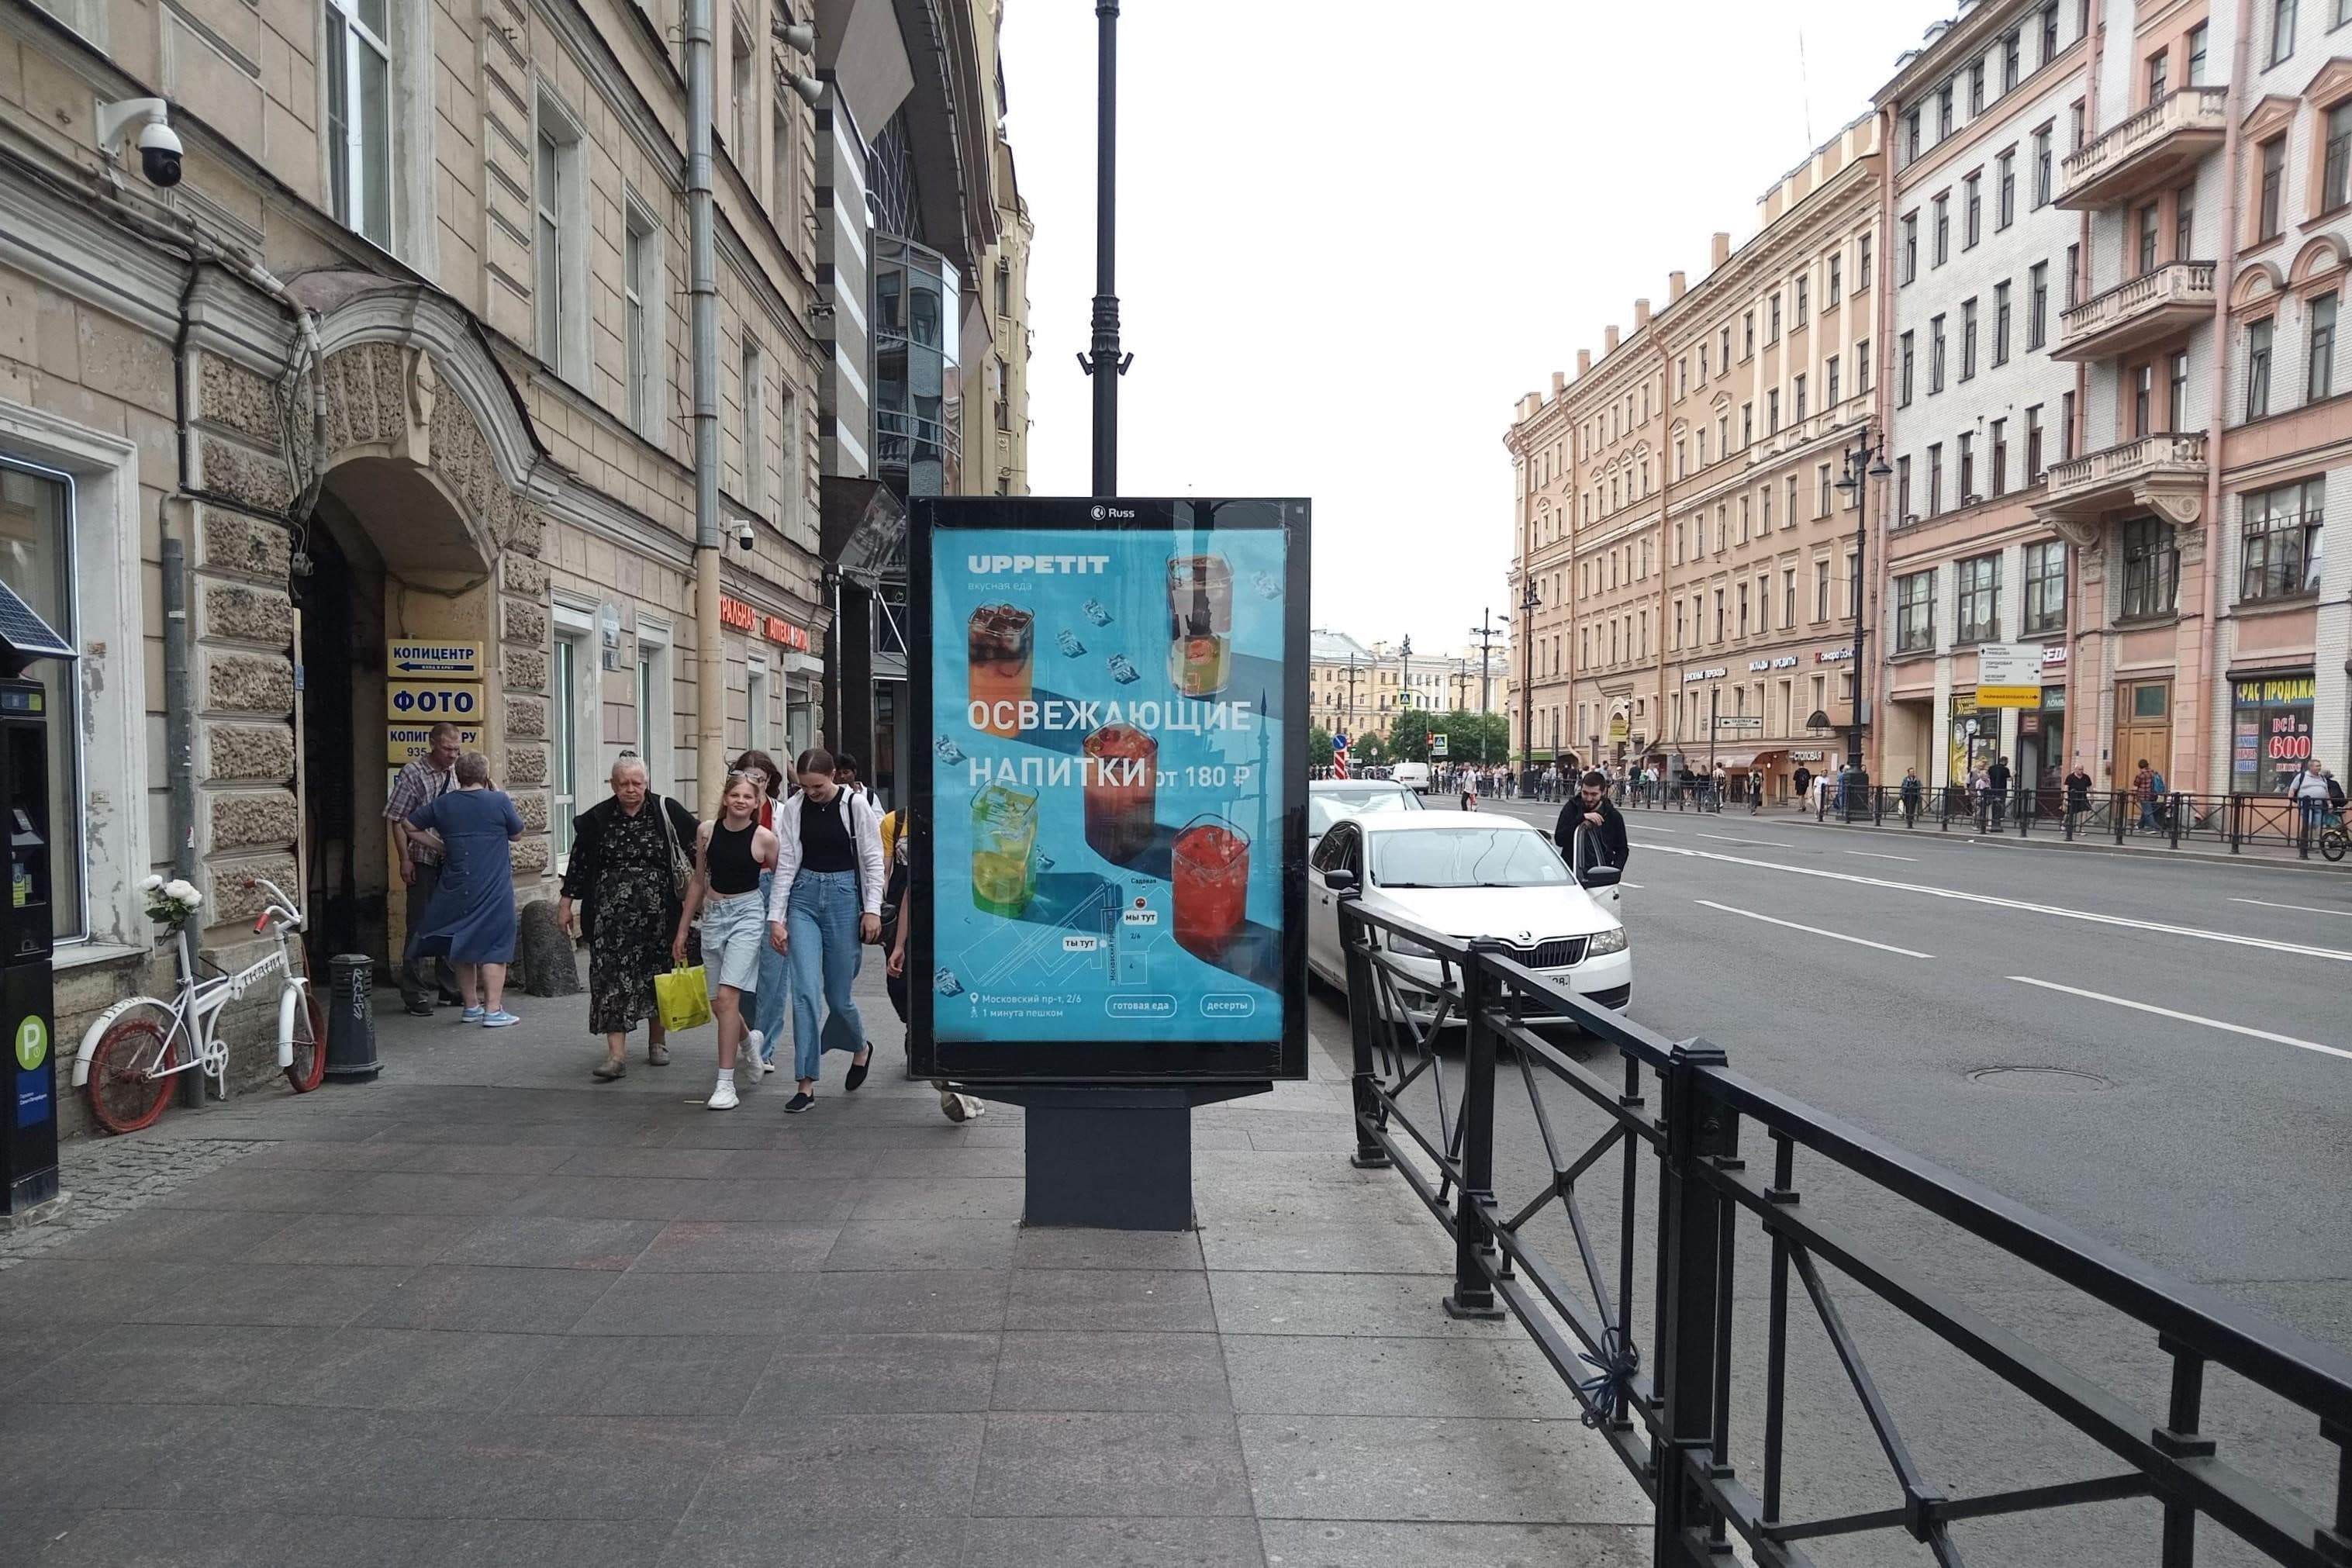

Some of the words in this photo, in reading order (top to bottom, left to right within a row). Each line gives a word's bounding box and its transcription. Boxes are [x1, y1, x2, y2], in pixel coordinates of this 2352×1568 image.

[1108, 508, 1135, 518] Russ
[968, 555, 1110, 574] UPPETIT
[968, 582, 1010, 592] вкусная
[1013, 582, 1032, 591] еда
[393, 647, 475, 661] КОПИЦЕНТР
[1773, 656, 1798, 669] КРЕДИТЫ
[2264, 679, 2315, 703] ПРОДАЖА
[392, 690, 474, 713] ФОТО
[968, 699, 1252, 737] ОСВЕЖАЮЩИЕ
[2272, 714, 2295, 733] ВСЁ
[2268, 736, 2311, 759] 600
[1794, 751, 1822, 762] СТОЛОВАЯ
[969, 757, 1146, 787] НАПИТКИ
[1155, 771, 1179, 787] от
[1186, 766, 1226, 787] 180
[1233, 766, 1250, 787] ₽
[242, 955, 283, 986] ТКАНИ
[982, 994, 1039, 1003] Московский
[1041, 996, 1065, 1005] пр-т,
[1066, 994, 1082, 1003] 2/6
[1113, 1002, 1149, 1010] готовая
[1207, 1001, 1248, 1011] десерты
[983, 1009, 987, 1017] 1
[989, 1010, 1024, 1019] минута
